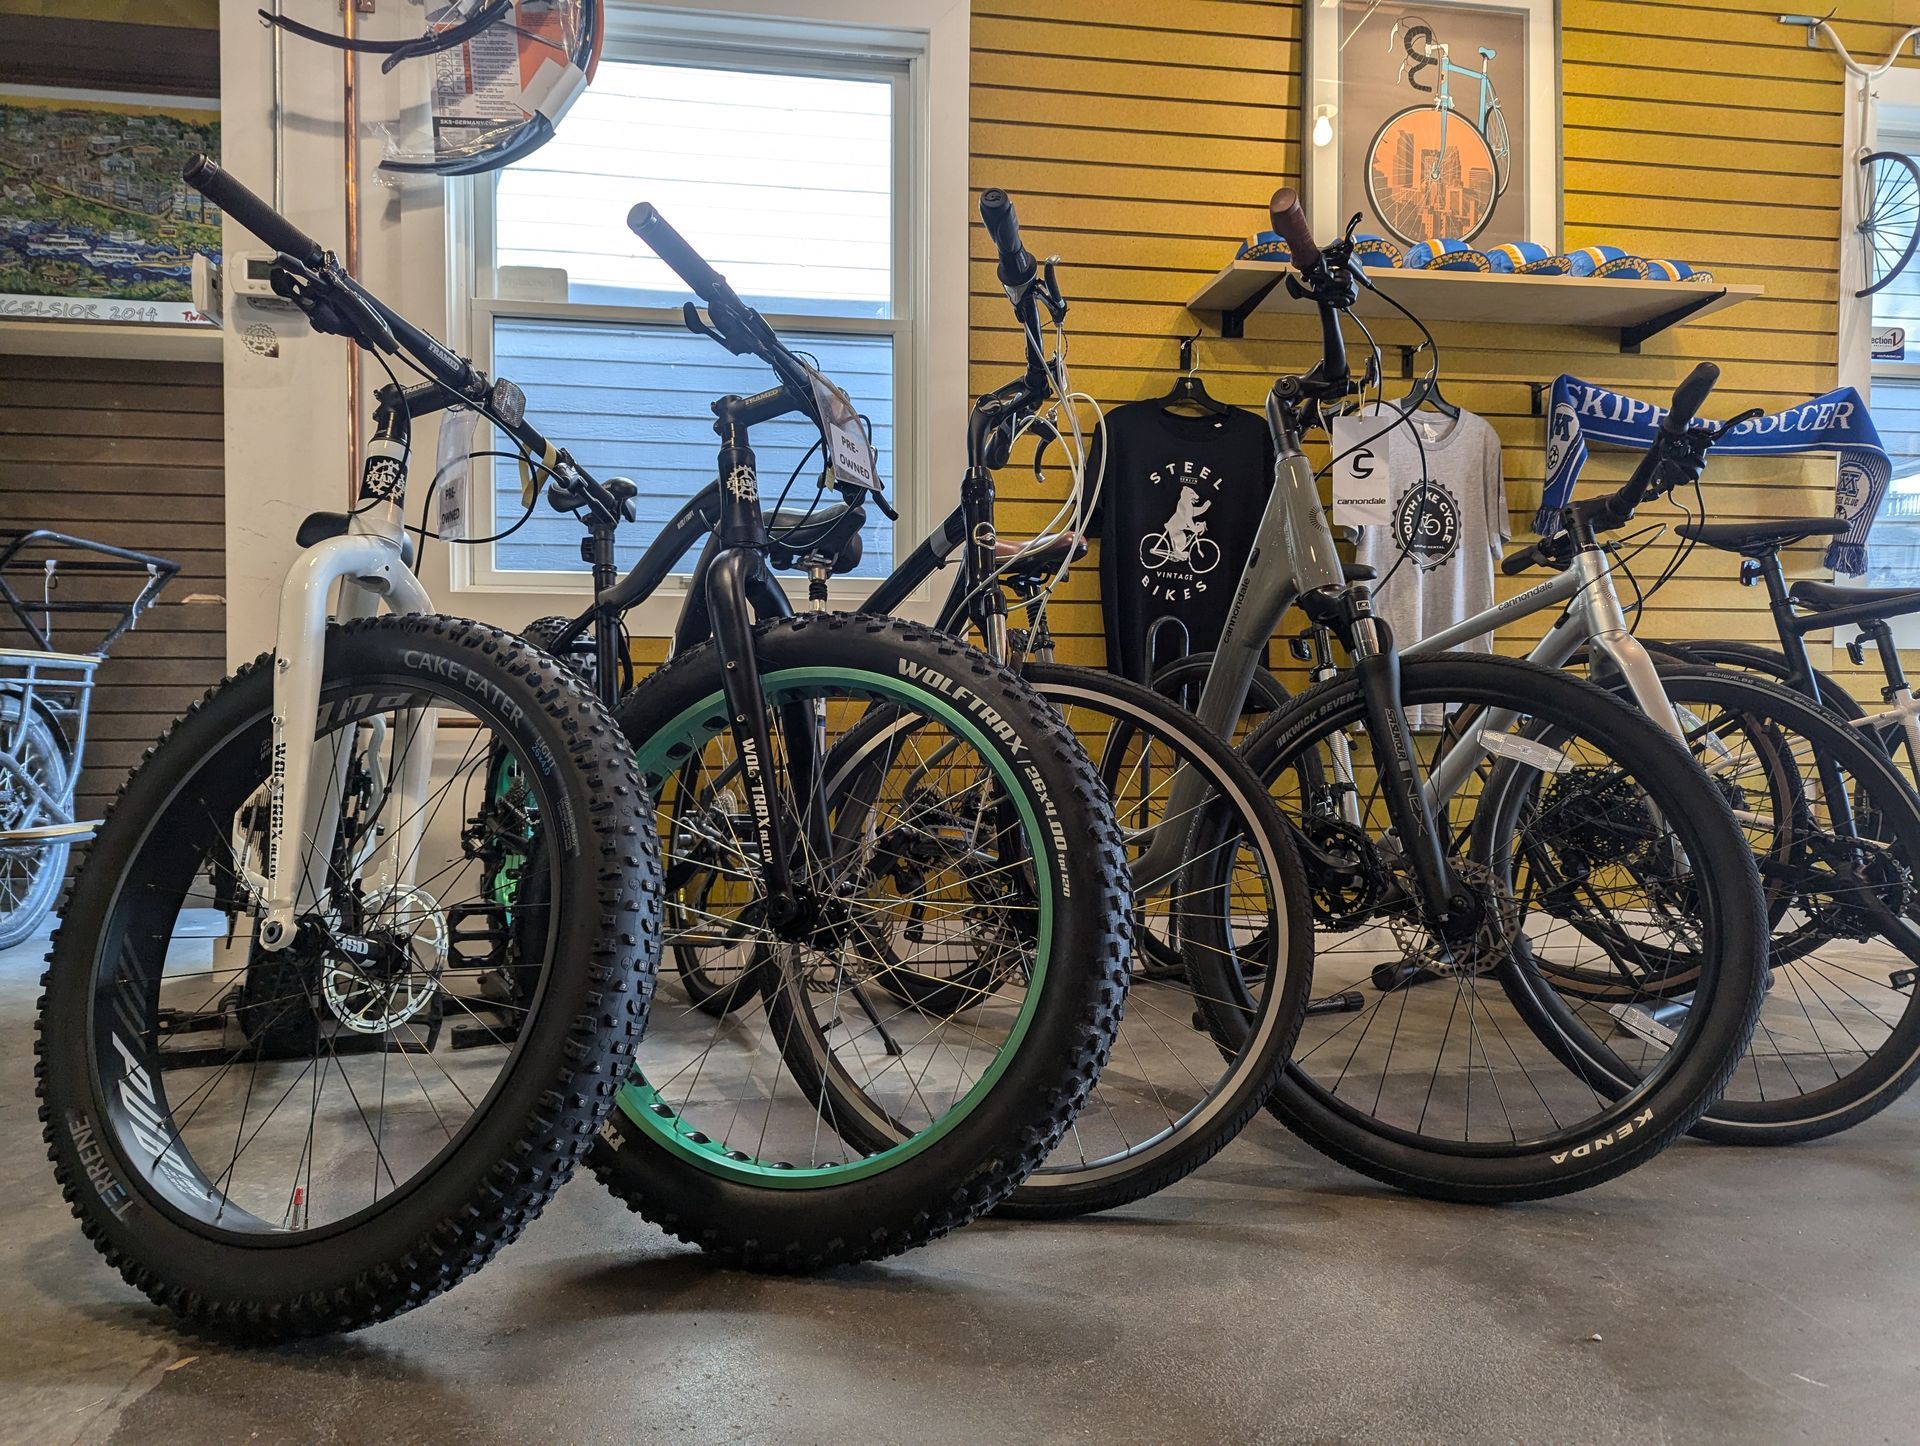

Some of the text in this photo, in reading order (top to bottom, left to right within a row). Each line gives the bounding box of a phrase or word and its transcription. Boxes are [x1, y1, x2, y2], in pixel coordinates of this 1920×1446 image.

[109, 305, 158, 322] 2014
[428, 342, 460, 371] FRAMED
[746, 390, 780, 405] FRAMED
[1732, 401, 1855, 436] SOCCER
[841, 435, 859, 454] PRE-
[839, 453, 870, 480] OWNED
[1150, 461, 1223, 491] STEEL
[445, 486, 456, 501] PRE-
[1337, 497, 1386, 505] cannondale
[441, 508, 460, 525] OWNED
[1417, 492, 1439, 504] LKE
[1440, 502, 1454, 543] CYCLE
[1141, 575, 1207, 601] BIKES
[1156, 571, 1193, 581] VINTAGE
[1224, 577, 1250, 644] cannondale
[1497, 581, 1553, 611] cannondale
[404, 650, 525, 729] CAKE EATER
[899, 657, 1029, 755] WOLFTRAX
[535, 735, 558, 768] LIGHT
[759, 829, 774, 865] ALLOY
[1550, 1107, 1654, 1165] KENDA
